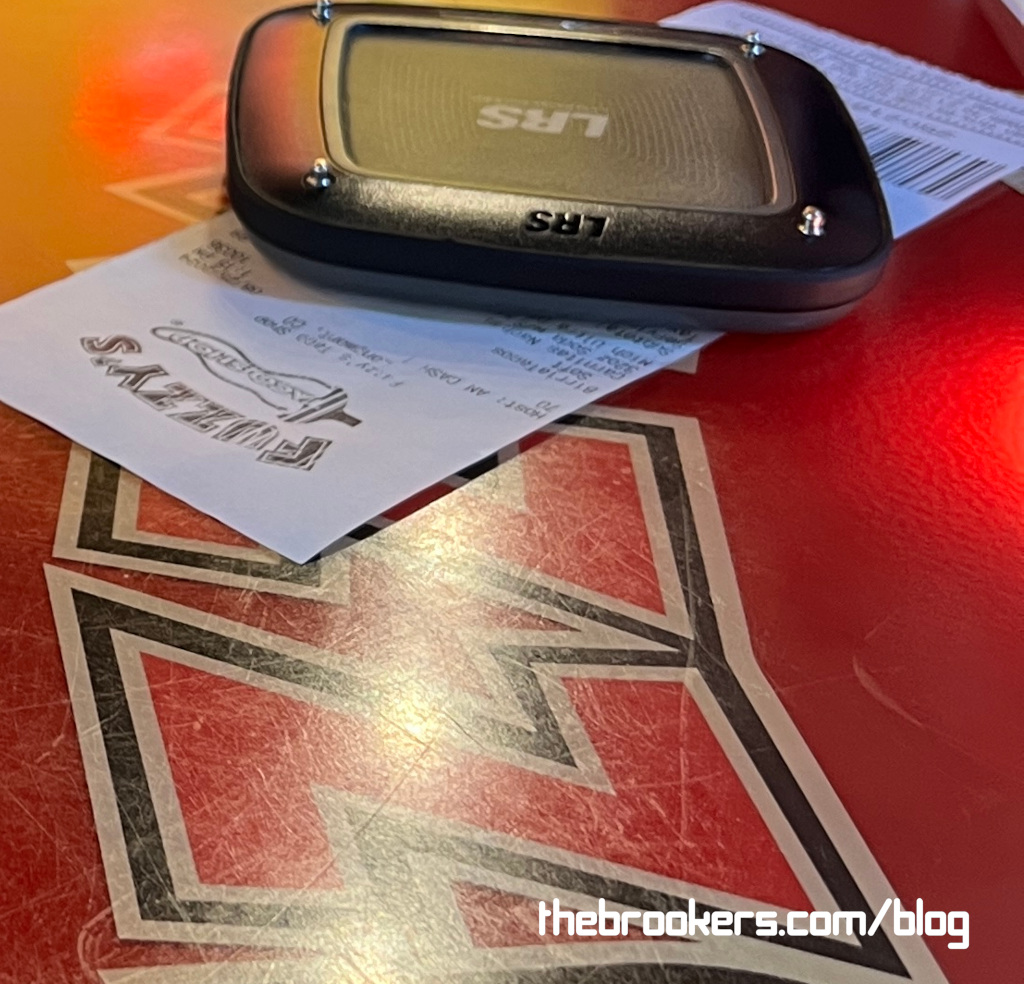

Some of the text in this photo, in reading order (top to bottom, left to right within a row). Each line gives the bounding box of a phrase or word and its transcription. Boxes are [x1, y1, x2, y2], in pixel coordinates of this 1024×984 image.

[476, 104, 609, 138] LRS
[525, 210, 610, 238] LRS
[254, 315, 292, 336] Shop
[491, 346, 599, 394] BirriaTacos
[546, 344, 626, 380] Carnitas
[551, 360, 593, 381] Soft
[79, 334, 333, 471] FUZZY'S
[464, 384, 491, 397] AN
